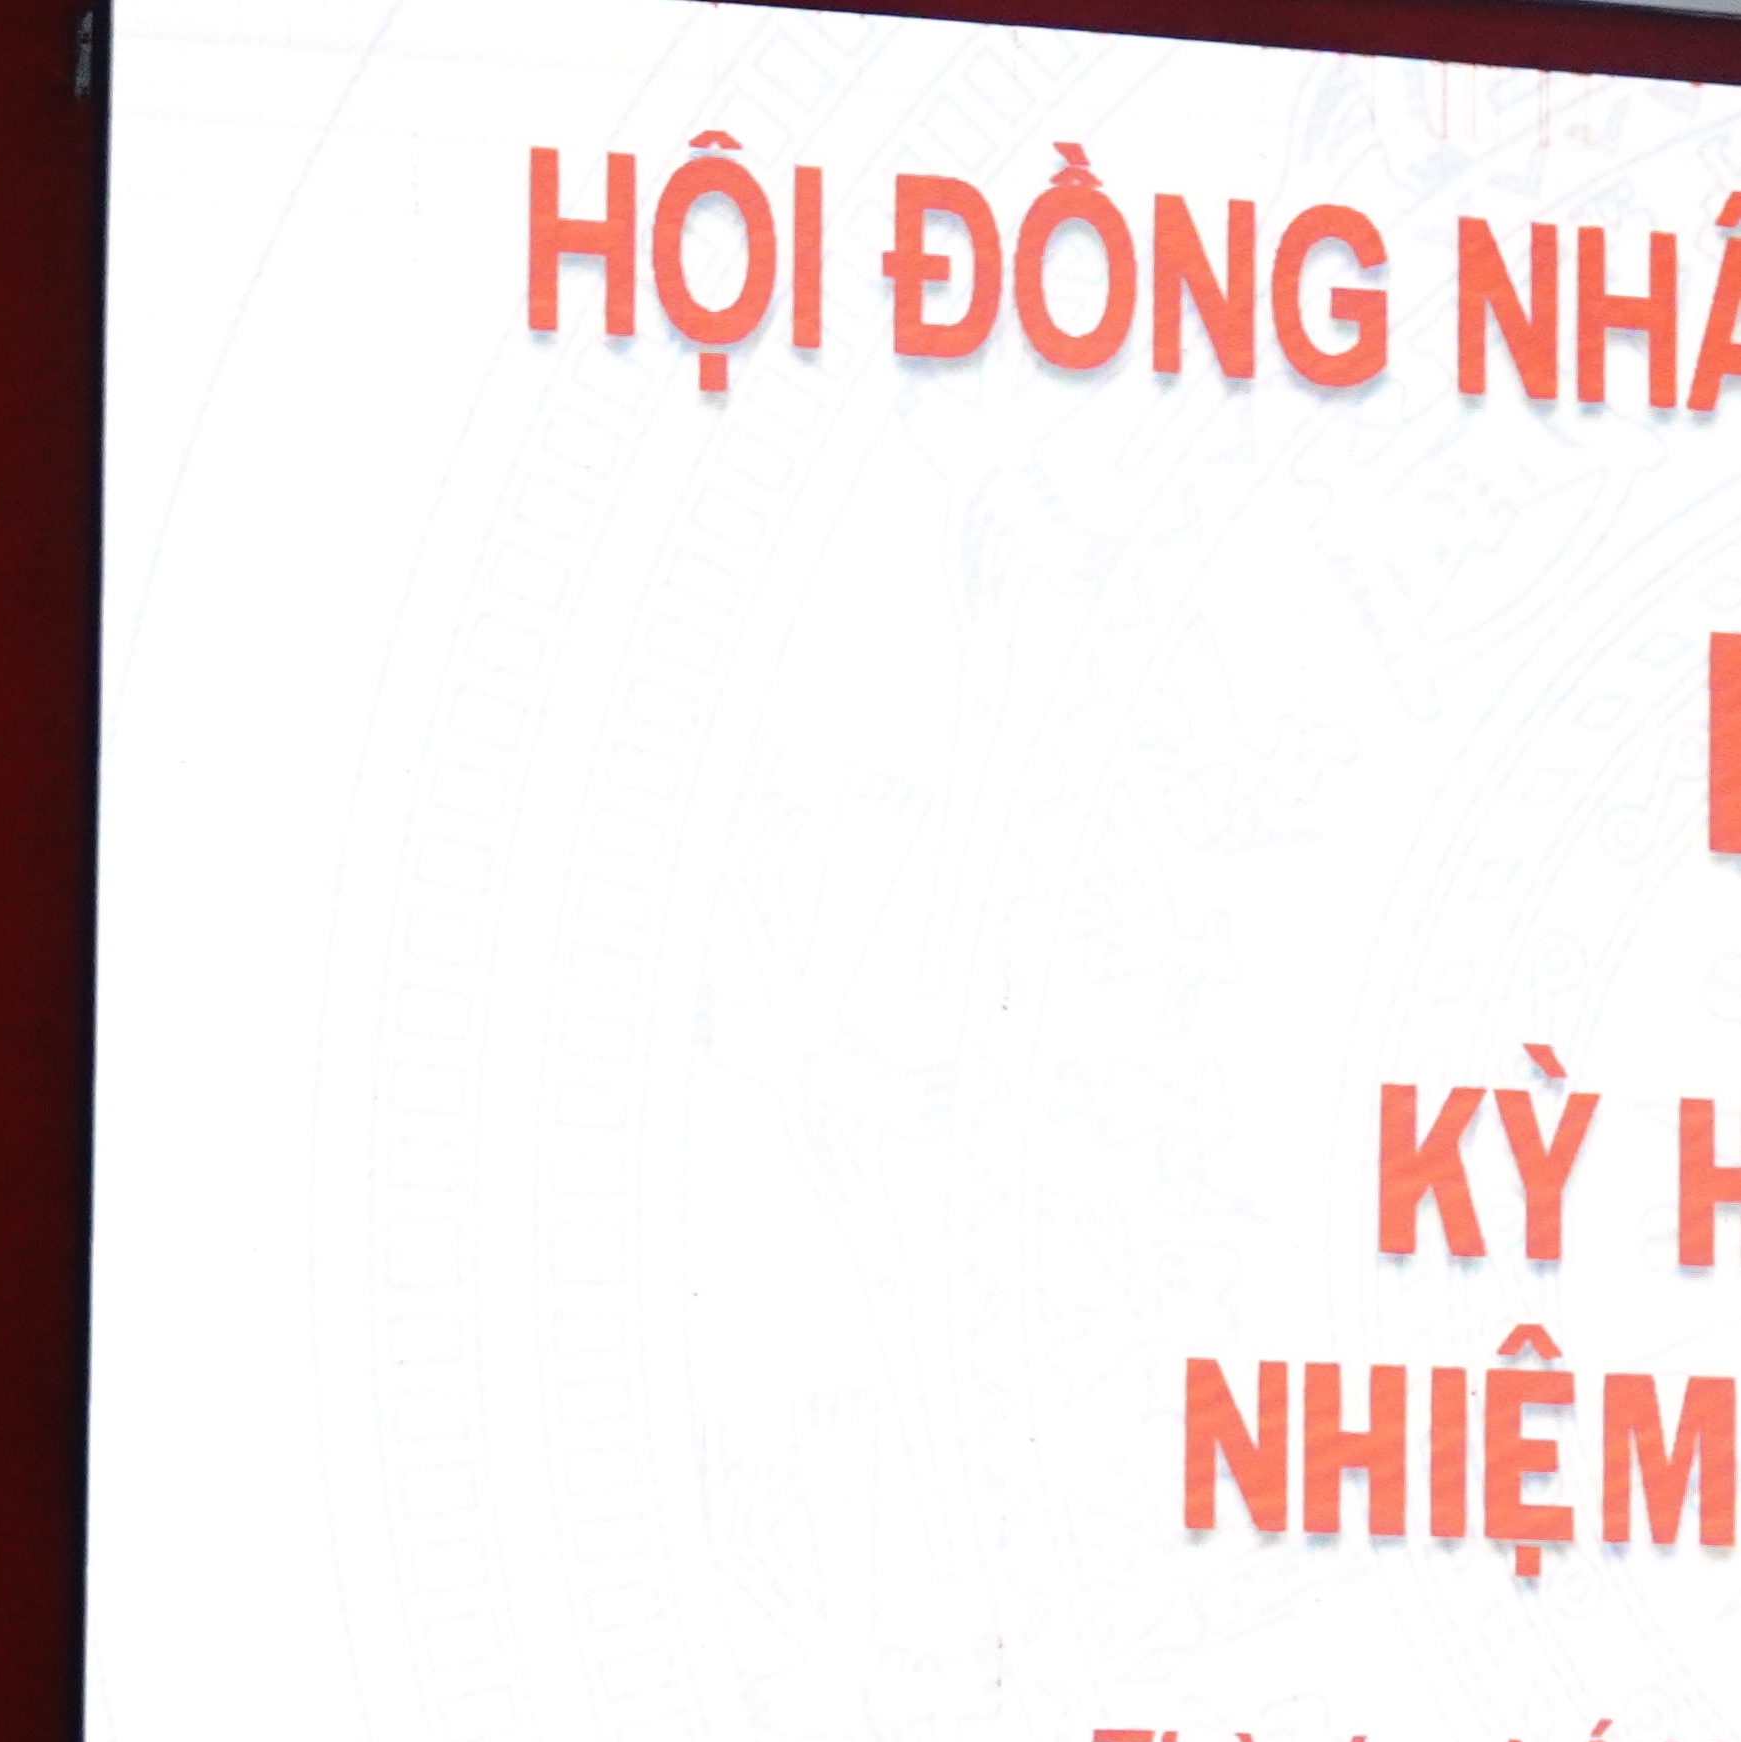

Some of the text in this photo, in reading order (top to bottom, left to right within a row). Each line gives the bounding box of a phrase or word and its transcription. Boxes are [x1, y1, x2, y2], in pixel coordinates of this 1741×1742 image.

[529, 130, 822, 393] HỘI
[882, 142, 1388, 388] ĐỒNG
[1379, 1043, 1600, 1261] KỲ
[1184, 1323, 1736, 1577] NHIỆM
